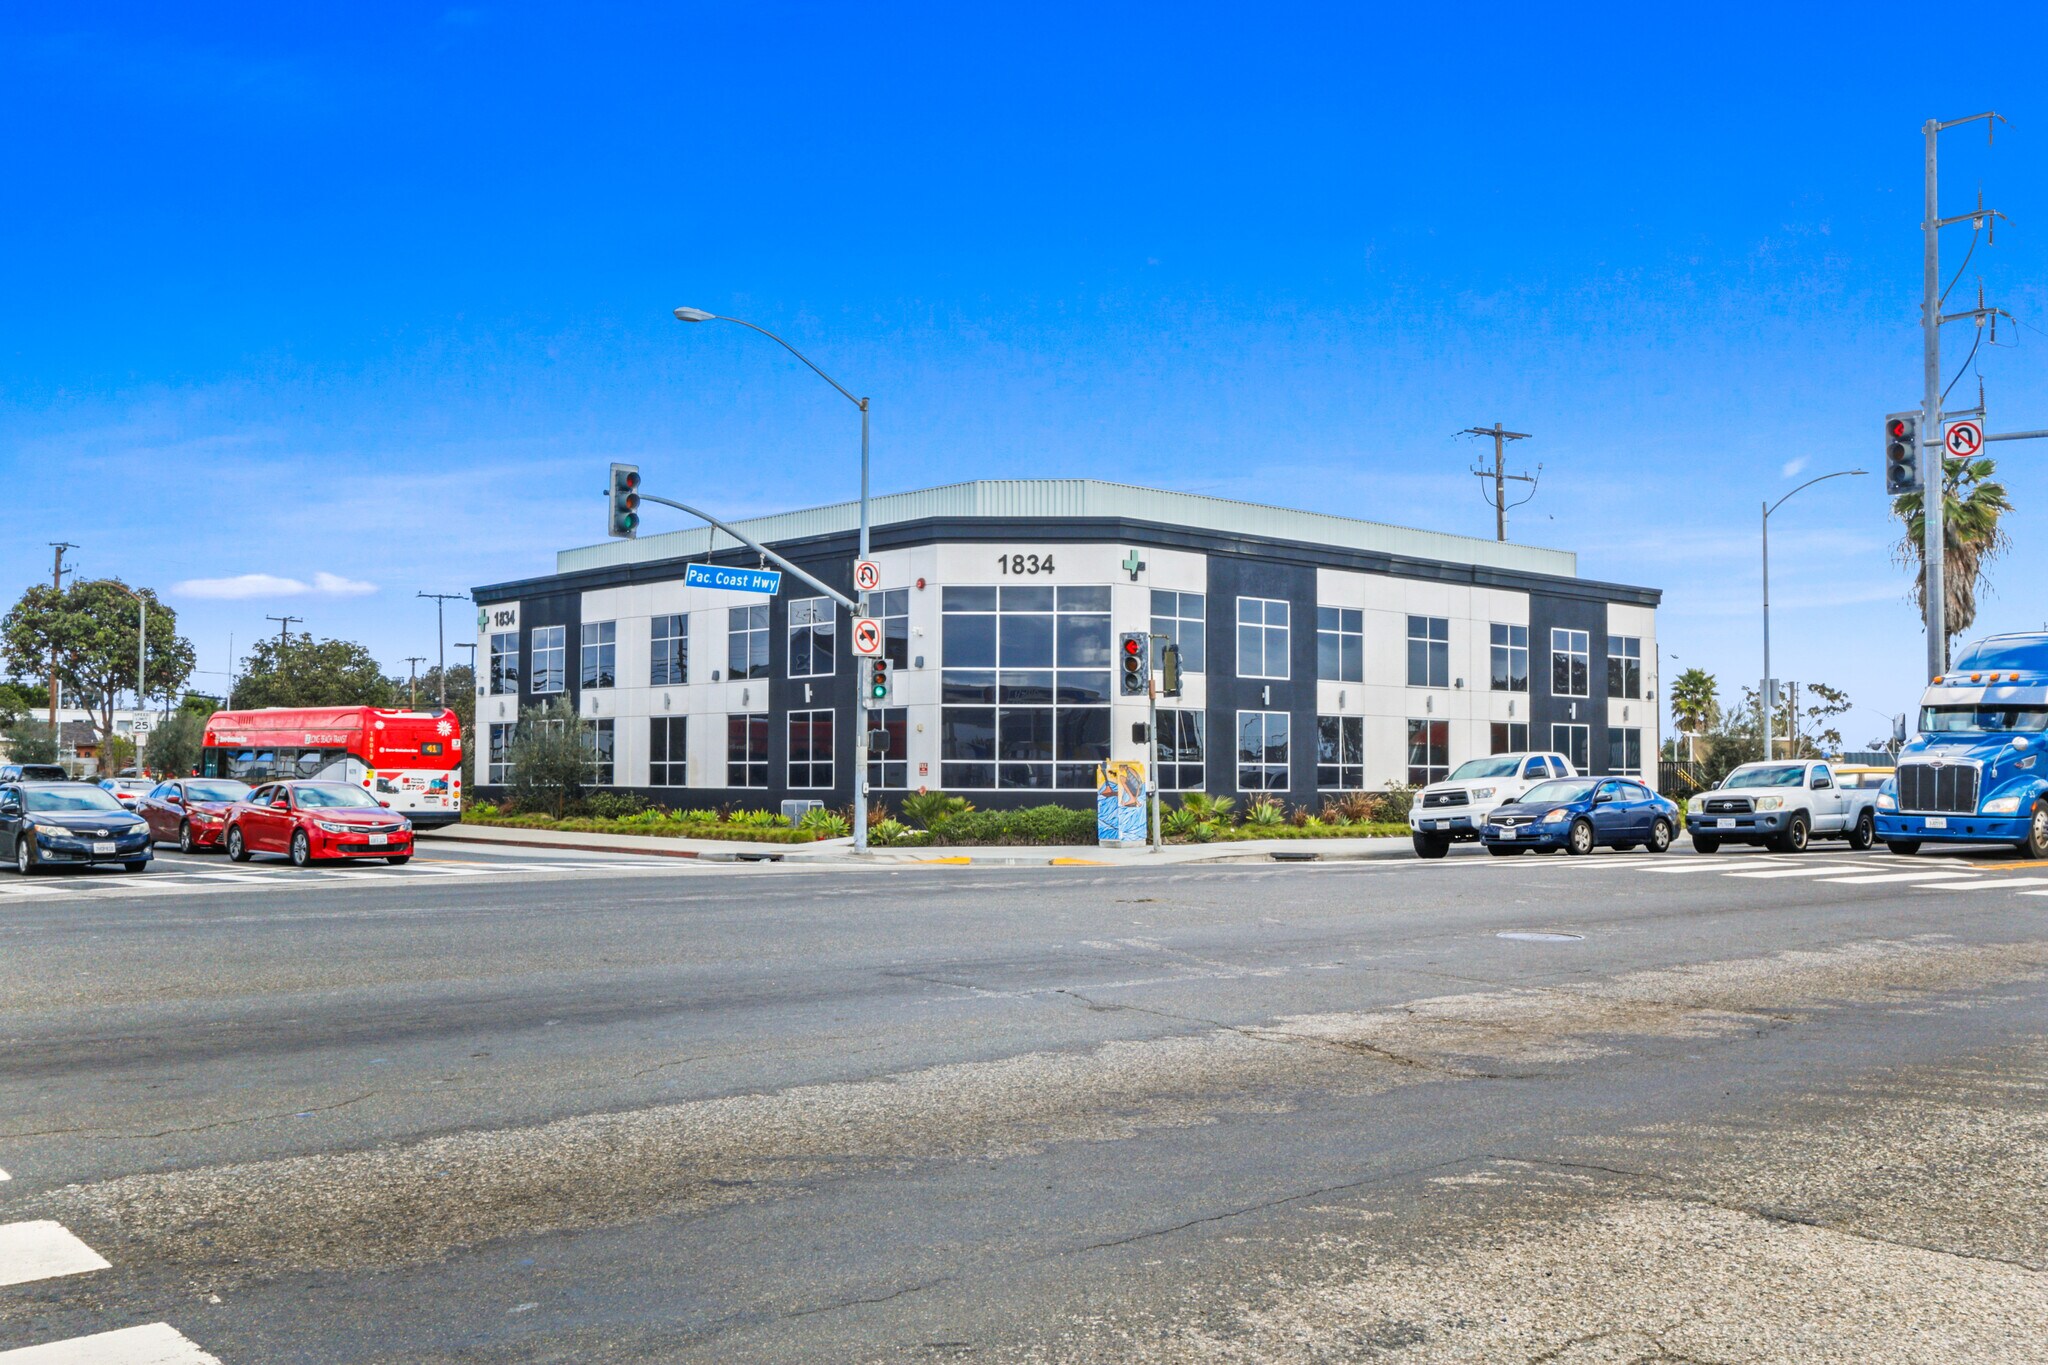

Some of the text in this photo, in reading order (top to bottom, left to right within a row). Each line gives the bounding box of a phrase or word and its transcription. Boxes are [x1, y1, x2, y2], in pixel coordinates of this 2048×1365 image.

[998, 554, 1055, 575] 1834
[688, 570, 776, 592] Pac. Coast Hwy
[494, 610, 515, 627] 1834
[135, 721, 149, 730] 25
[426, 744, 437, 753] 41
